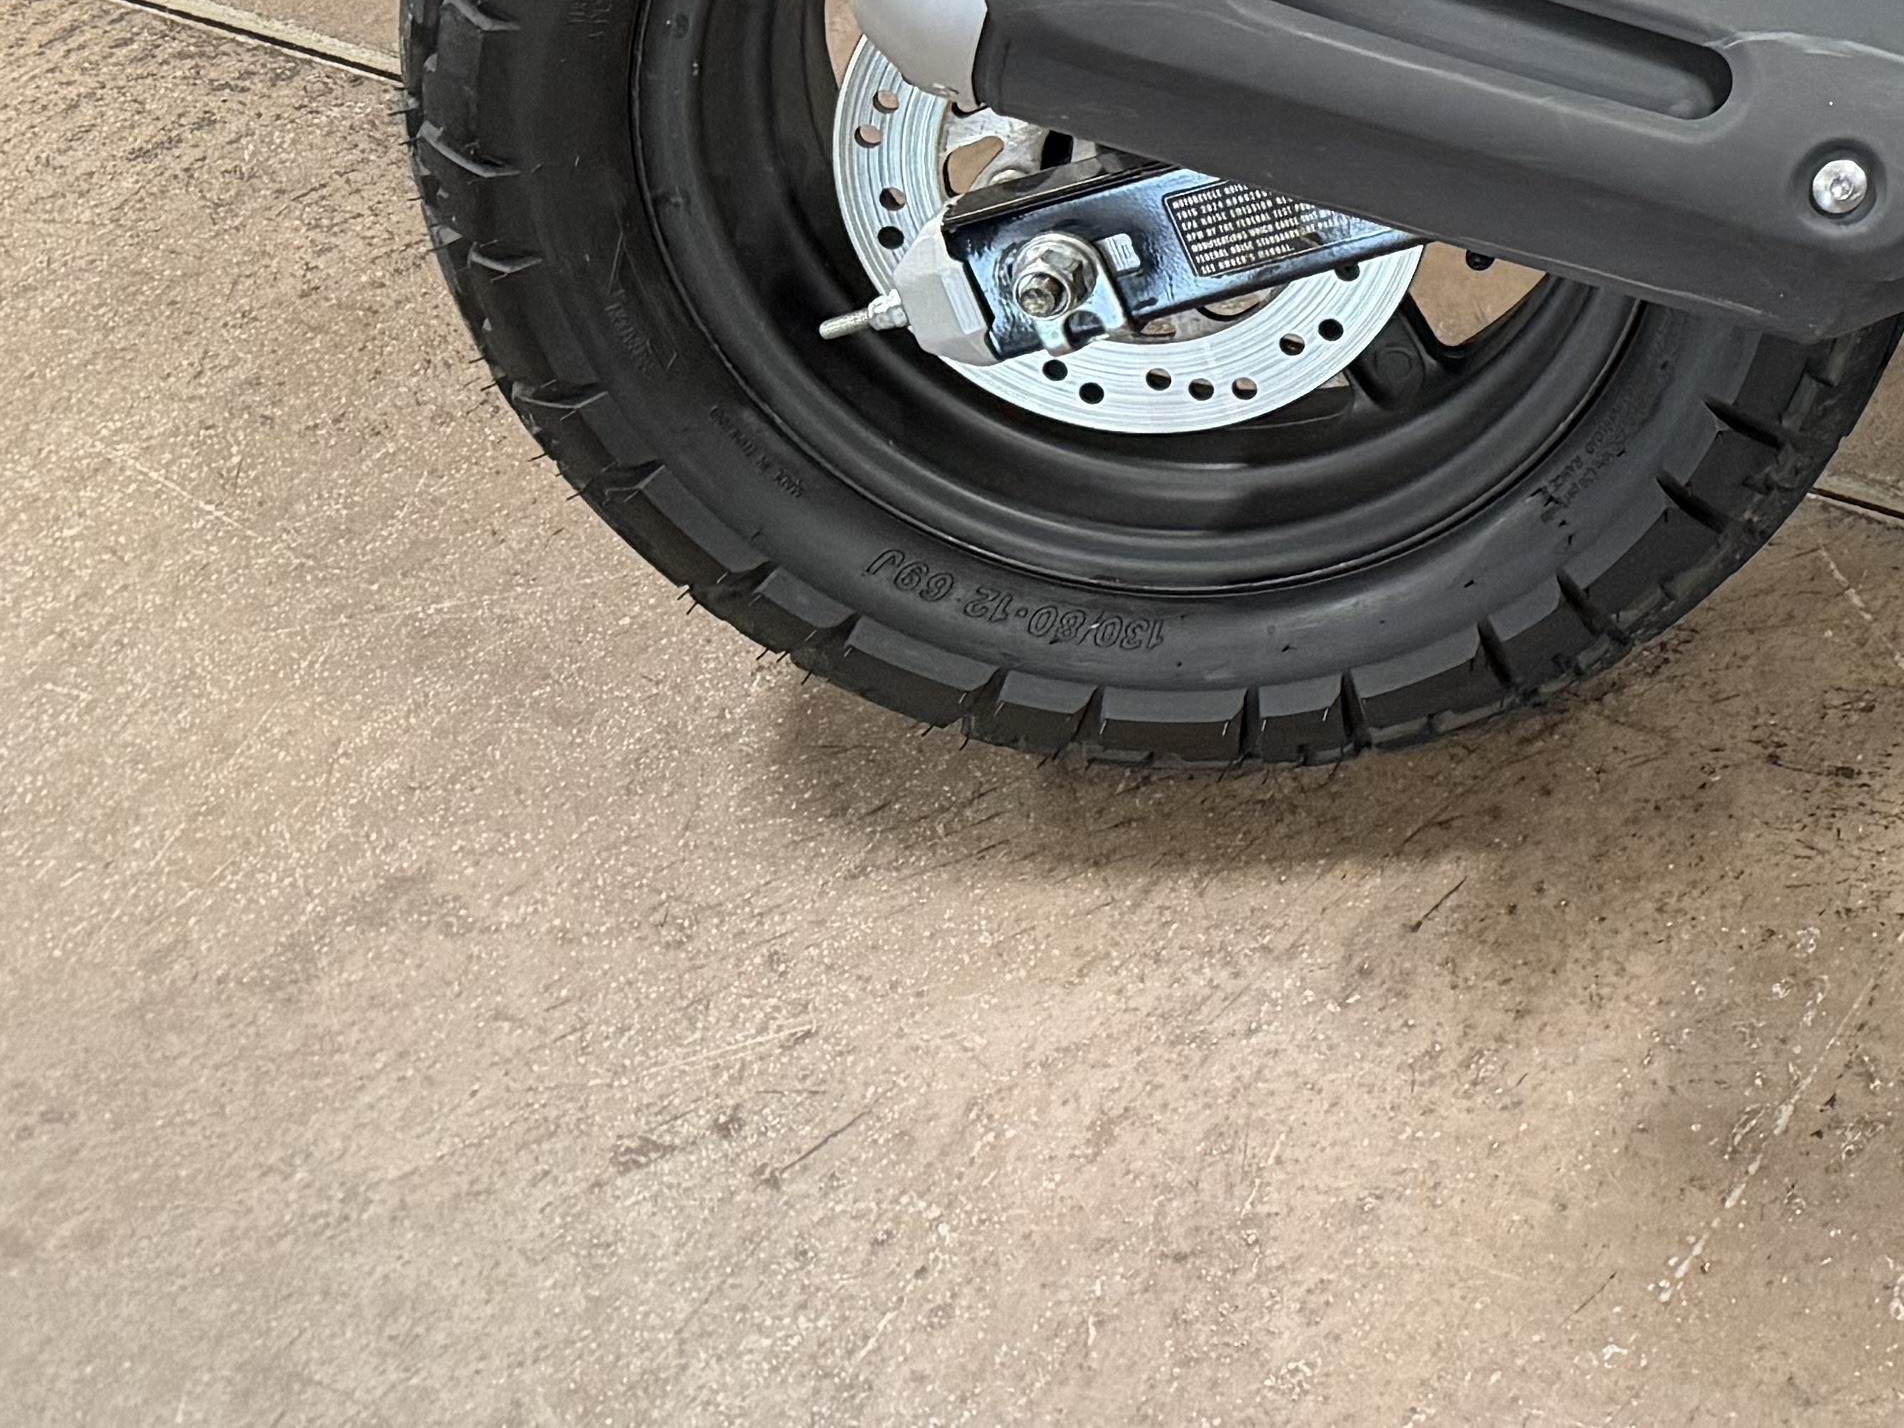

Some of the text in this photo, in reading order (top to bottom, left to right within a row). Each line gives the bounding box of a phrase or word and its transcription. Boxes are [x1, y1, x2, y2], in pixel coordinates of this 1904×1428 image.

[1235, 212, 1271, 227] FEDERAL
[1272, 206, 1292, 217] TEST
[862, 545, 952, 602] 69J
